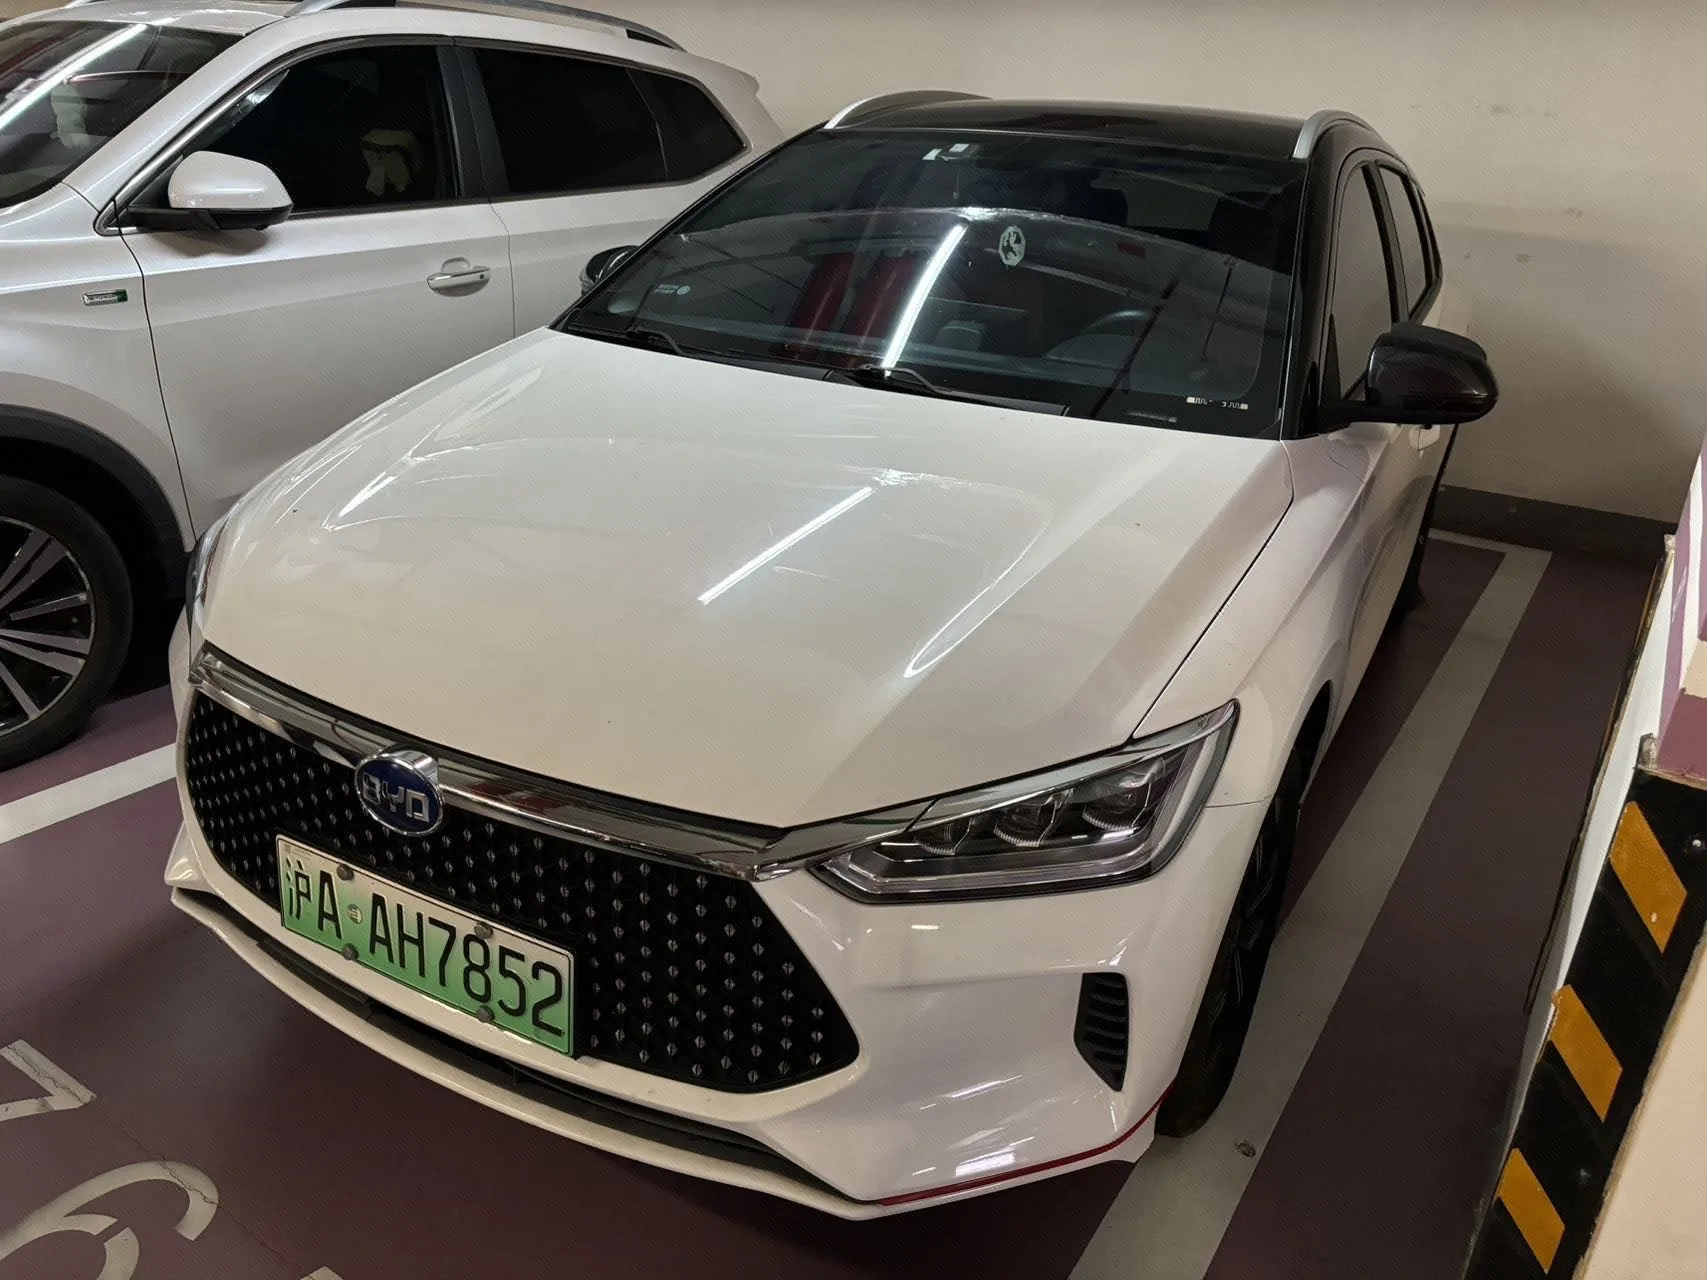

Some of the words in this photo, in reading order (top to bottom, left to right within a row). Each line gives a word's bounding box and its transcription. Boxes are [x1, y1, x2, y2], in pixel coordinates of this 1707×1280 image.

[362, 772, 430, 823] BYD
[285, 857, 343, 939] 沪A
[369, 892, 566, 1037] AH7852
